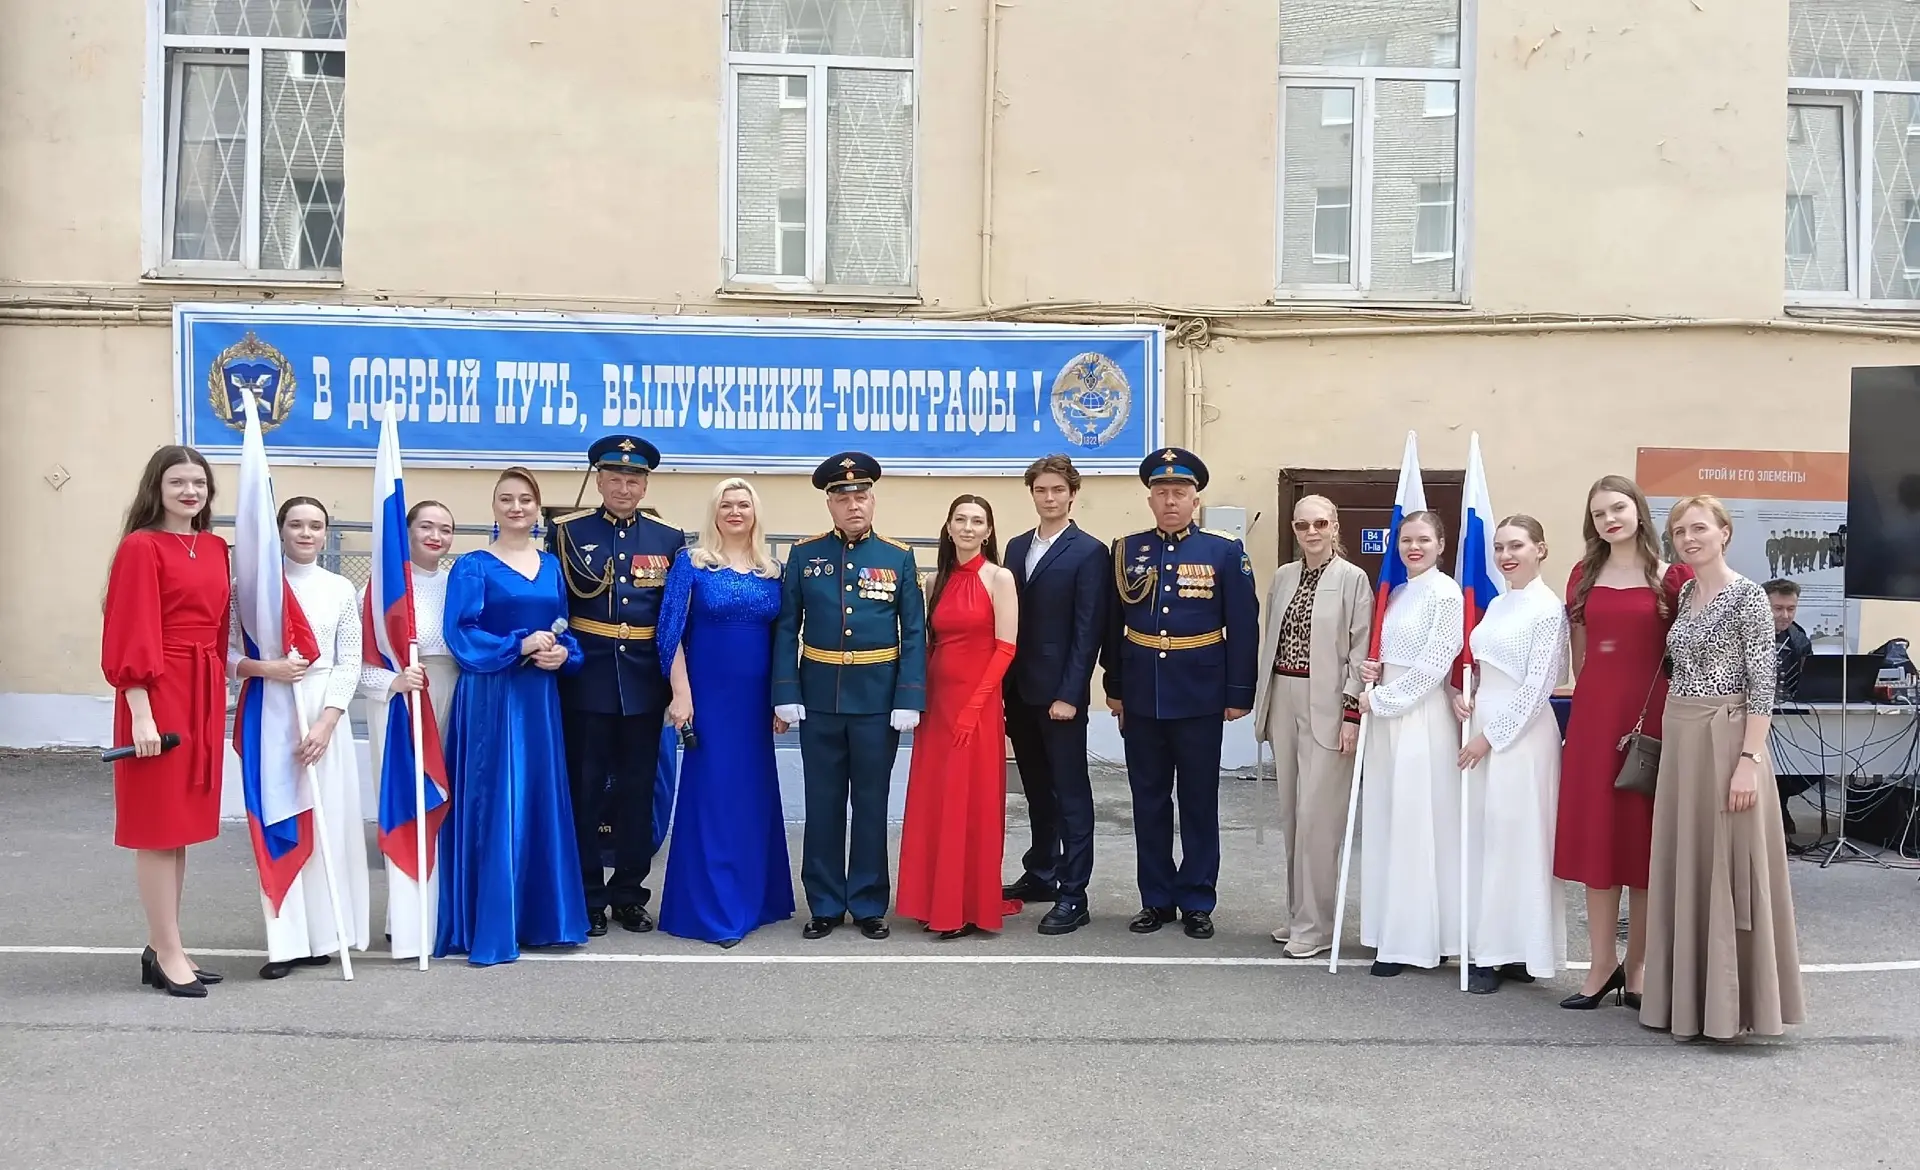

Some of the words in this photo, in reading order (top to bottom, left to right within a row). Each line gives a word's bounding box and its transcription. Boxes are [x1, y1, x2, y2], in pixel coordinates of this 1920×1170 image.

[313, 356, 332, 420] В
[347, 357, 480, 430] ДОБРЫЙ
[495, 361, 588, 433] ПУТЬ,
[602, 364, 1017, 436] ВЫПУСКНИКИ-ТОПОГРАФЫ
[1032, 370, 1043, 432] !
[1698, 468, 1727, 481] СТРОЙ
[1729, 468, 1736, 481] И
[1738, 469, 1755, 481] ЕГО
[1757, 470, 1806, 483] ЭЛЕМЕНТЫ
